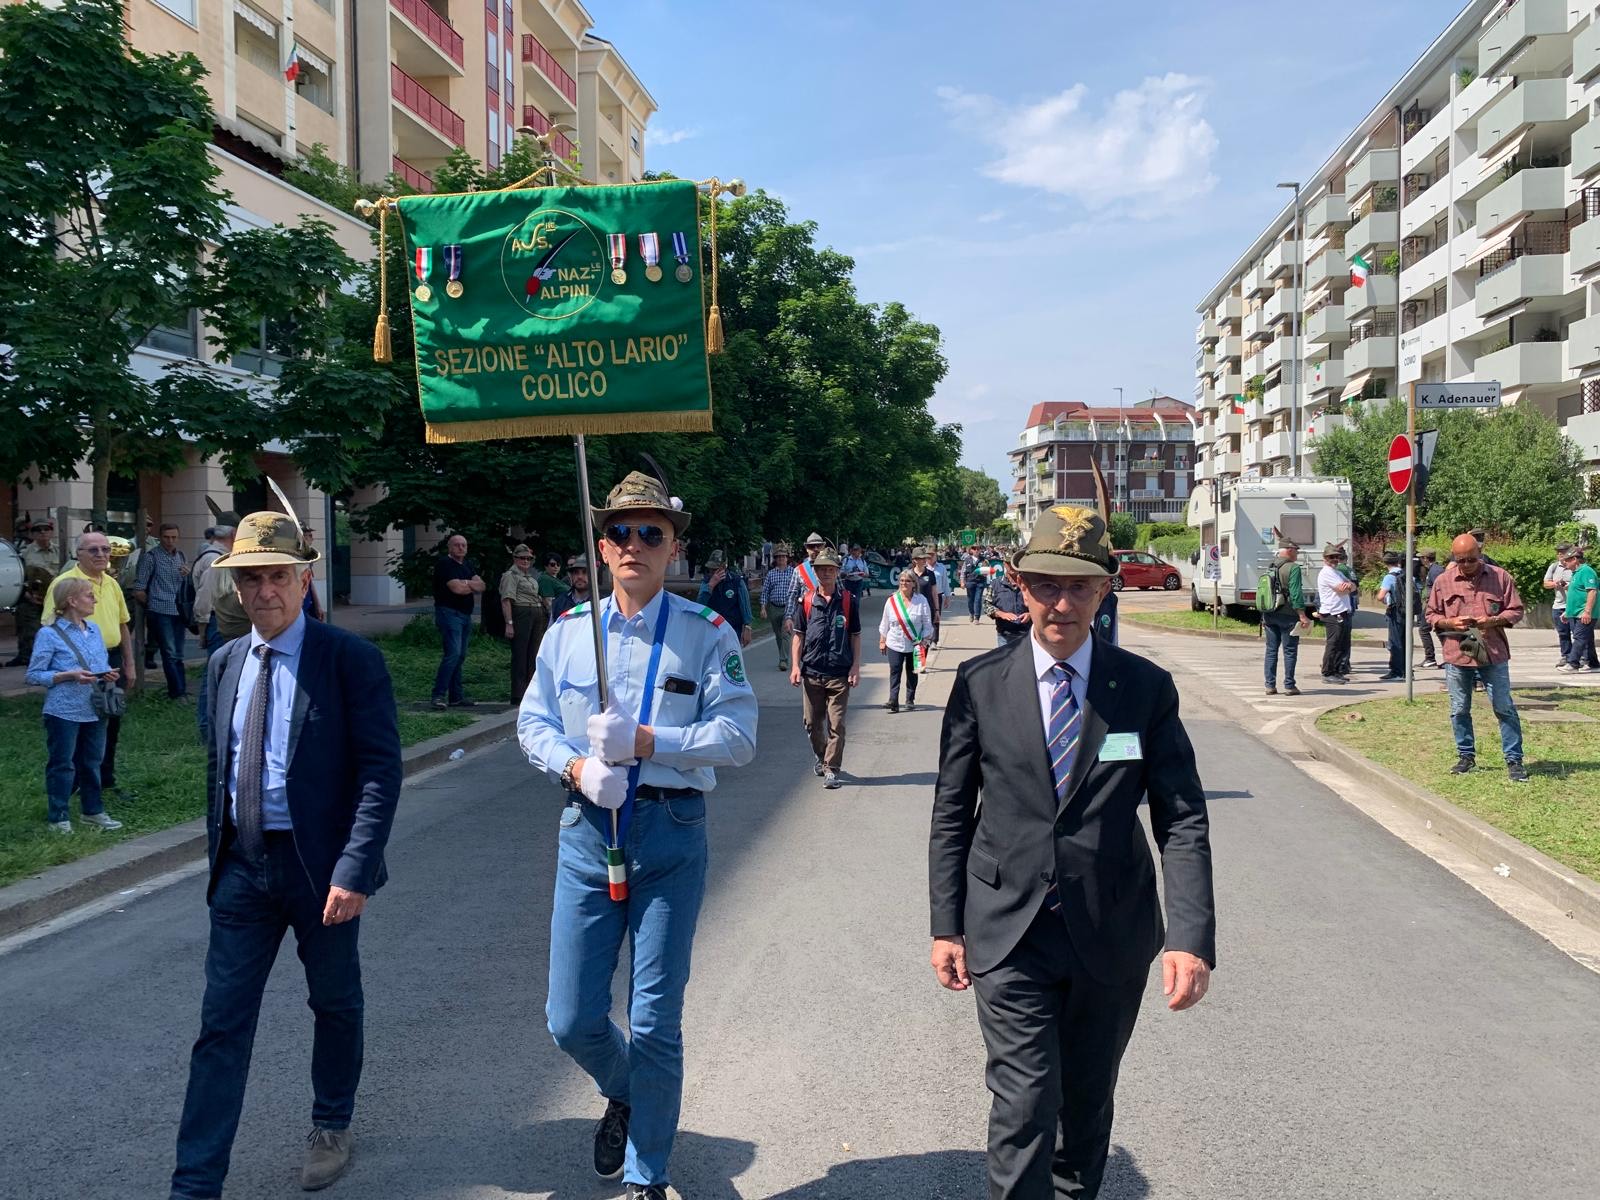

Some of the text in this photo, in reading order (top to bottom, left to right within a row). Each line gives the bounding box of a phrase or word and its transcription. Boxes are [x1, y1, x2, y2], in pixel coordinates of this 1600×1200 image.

[540, 284, 590, 300] ALPINI
[434, 345, 529, 376] SEZIONE
[521, 370, 608, 401] COLICO
[1421, 394, 1496, 404] K. Adenauer
